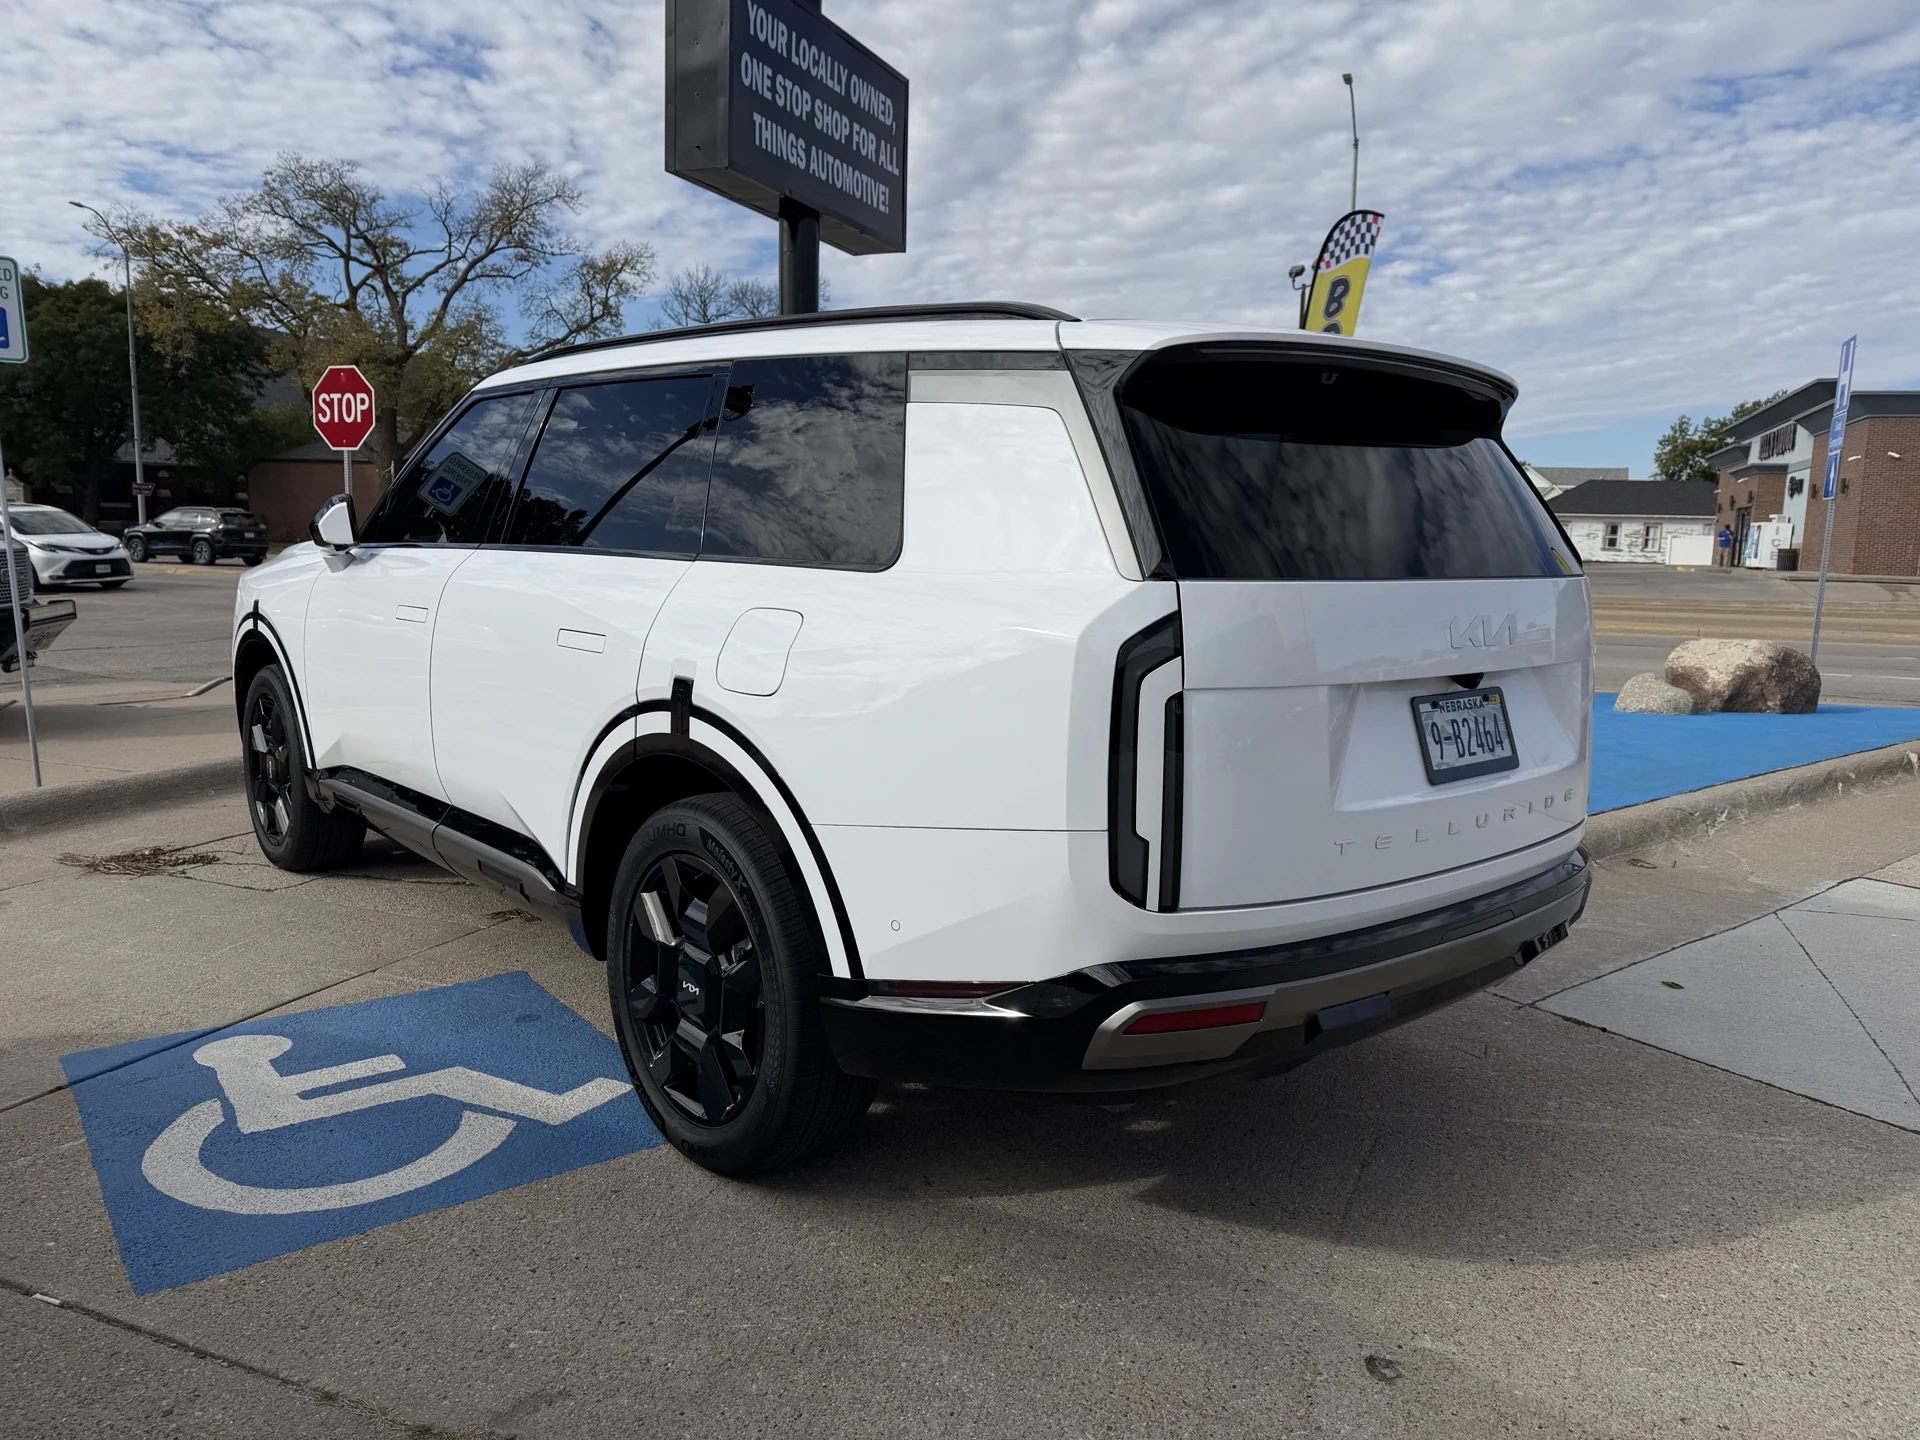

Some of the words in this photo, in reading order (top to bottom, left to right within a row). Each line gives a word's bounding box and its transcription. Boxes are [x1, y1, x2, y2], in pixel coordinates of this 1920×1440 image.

[746, 0, 788, 58] YOUR
[791, 31, 848, 97] LOCALLY
[850, 73, 896, 136] OWNED,
[740, 51, 773, 101] ONE
[775, 73, 812, 122] STOP
[814, 98, 850, 145] SHOP
[853, 121, 877, 163] FOR
[878, 140, 900, 177] ALL
[752, 111, 807, 171] THINGS
[809, 145, 890, 215] AUTOMOTIVE!
[317, 391, 370, 424] STOP
[1449, 613, 1515, 650] KIA
[1438, 697, 1486, 714] NEBRASKA
[1430, 712, 1505, 761] 9-B2464
[1333, 787, 1574, 856] TELLURIDE
